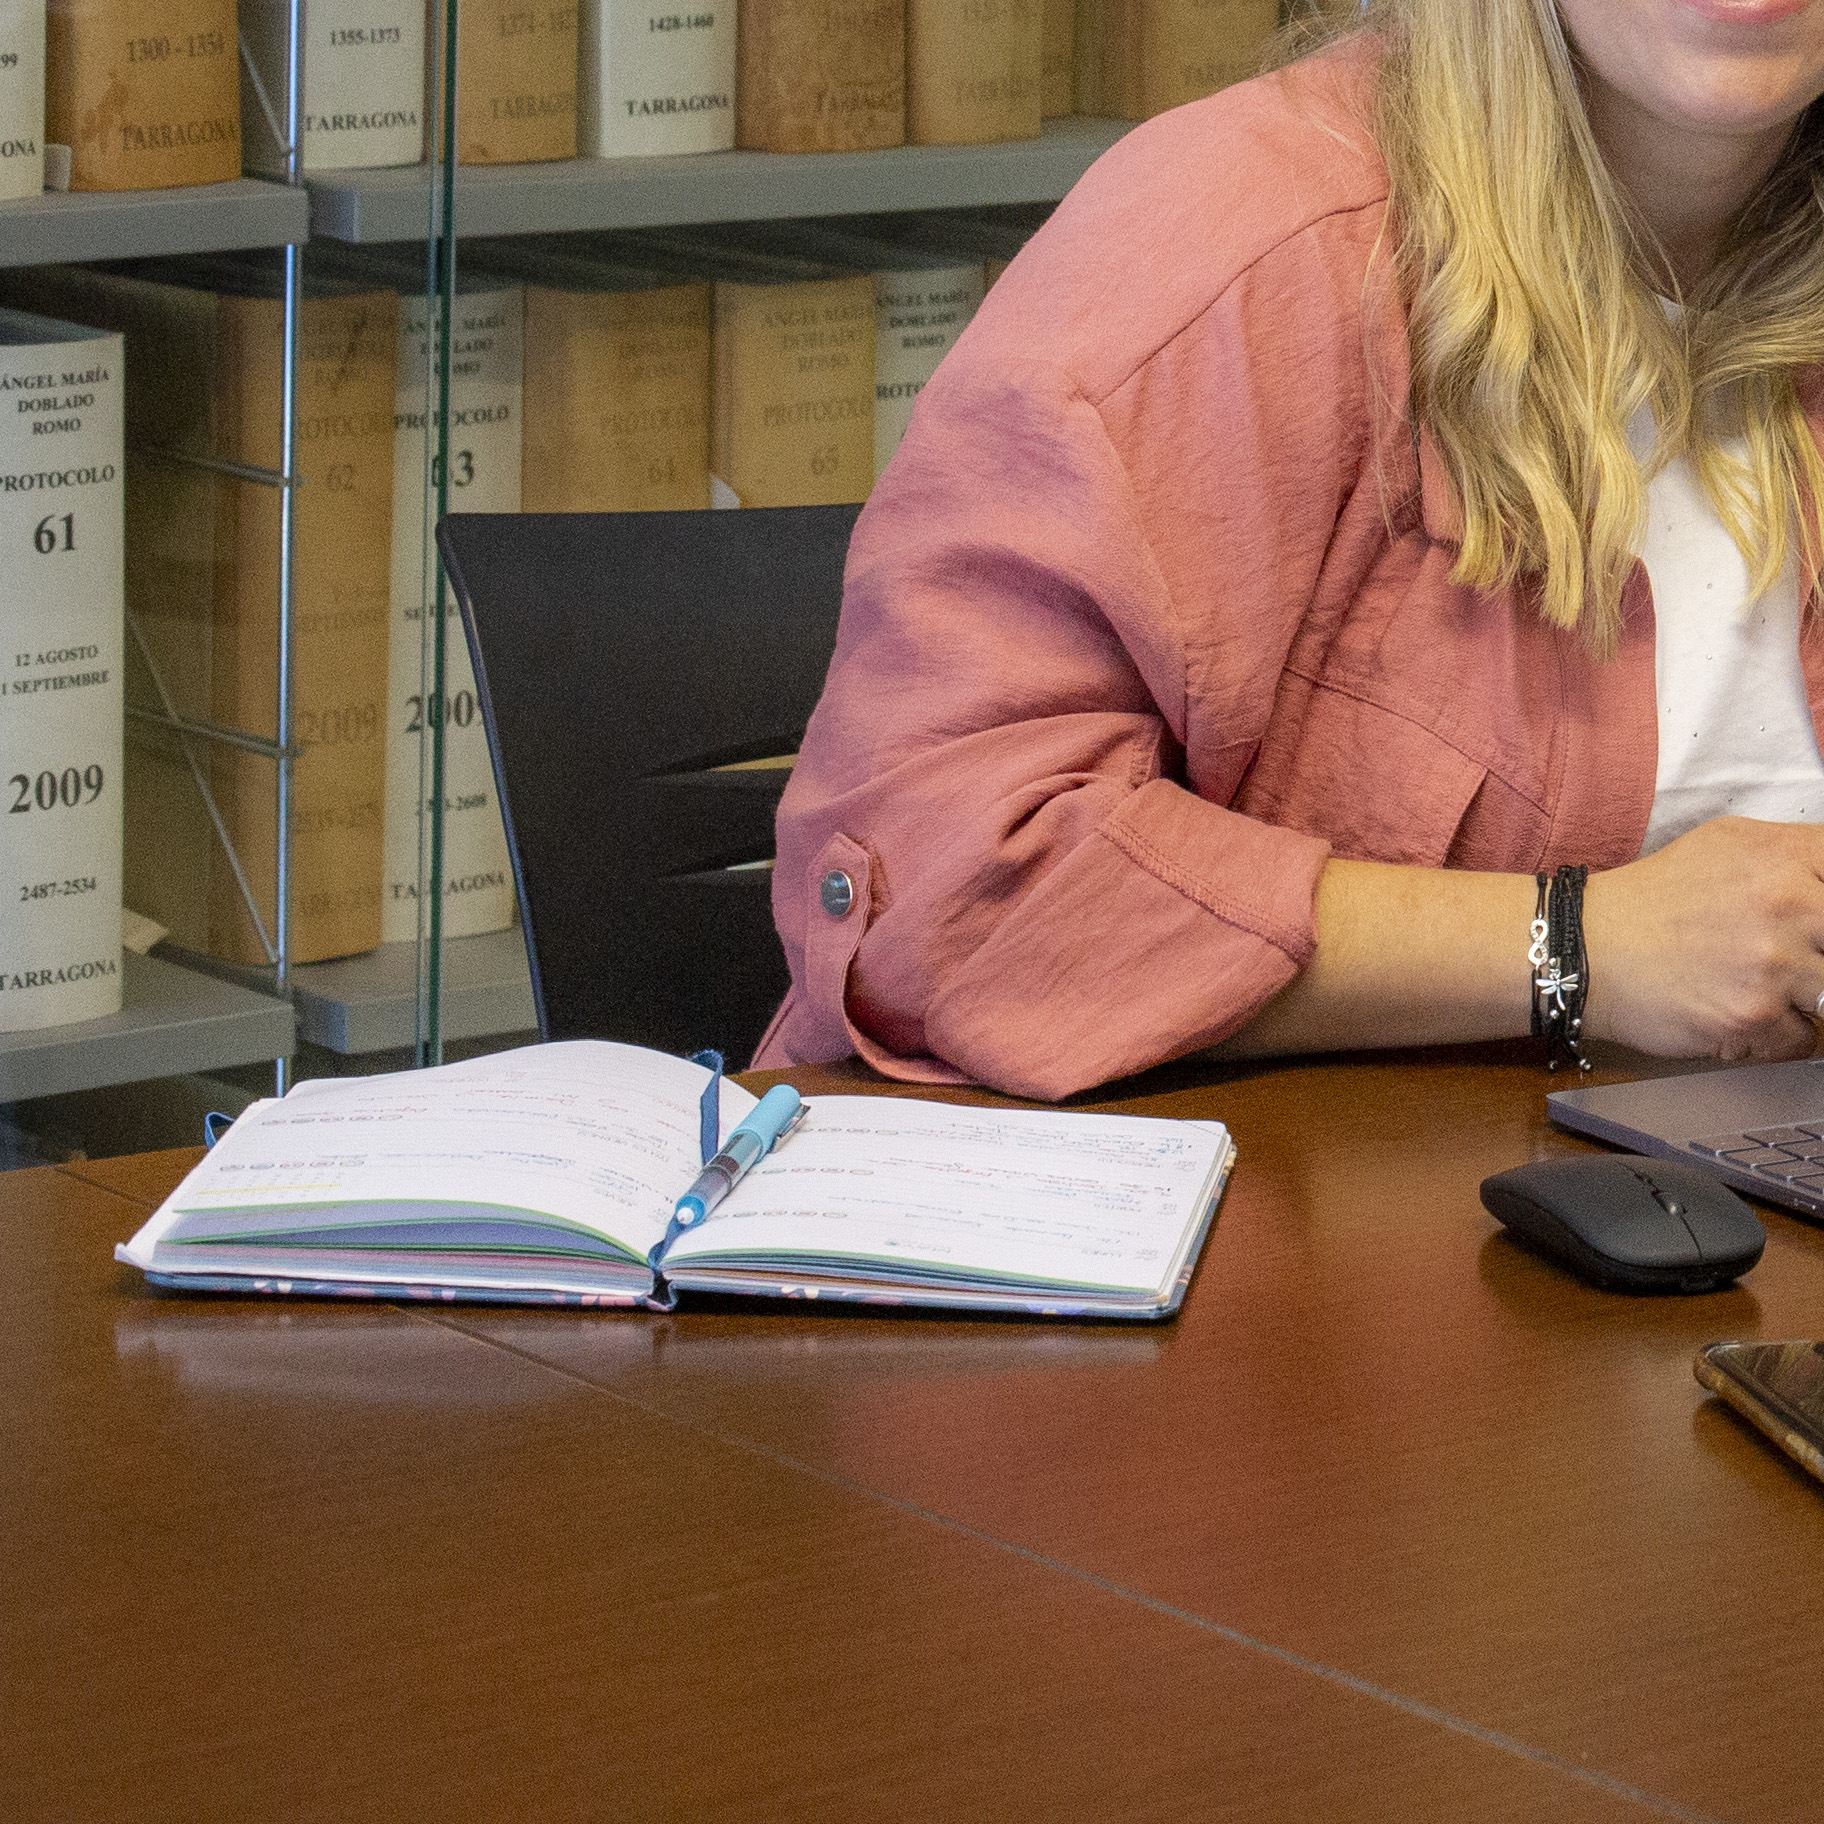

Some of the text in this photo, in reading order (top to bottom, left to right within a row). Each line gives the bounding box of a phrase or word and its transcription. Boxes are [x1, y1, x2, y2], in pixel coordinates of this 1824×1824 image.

[126, 38, 171, 63] 1300
[627, 94, 729, 116] TARRAGONA
[122, 118, 238, 151] TARRAGONA
[306, 112, 416, 132] TARRAGONA
[889, 312, 956, 329] DOBLADO
[902, 333, 945, 348] ROMO
[63, 367, 109, 384] MARÍA
[16, 393, 94, 414] DOBLADO
[763, 398, 871, 427] PROTOCOLO
[32, 417, 82, 436] ROMO
[647, 459, 675, 484] 64
[810, 449, 839, 474] 65
[326, 464, 354, 490] 62
[31, 512, 77, 555] 61
[34, 645, 99, 666] AGOSTO
[11, 670, 109, 695] SEPTIEMBRE
[302, 704, 377, 746] 2009
[8, 763, 104, 816] 2009
[19, 877, 96, 903] 2487-2534
[0, 960, 117, 991] TARRAGONA
